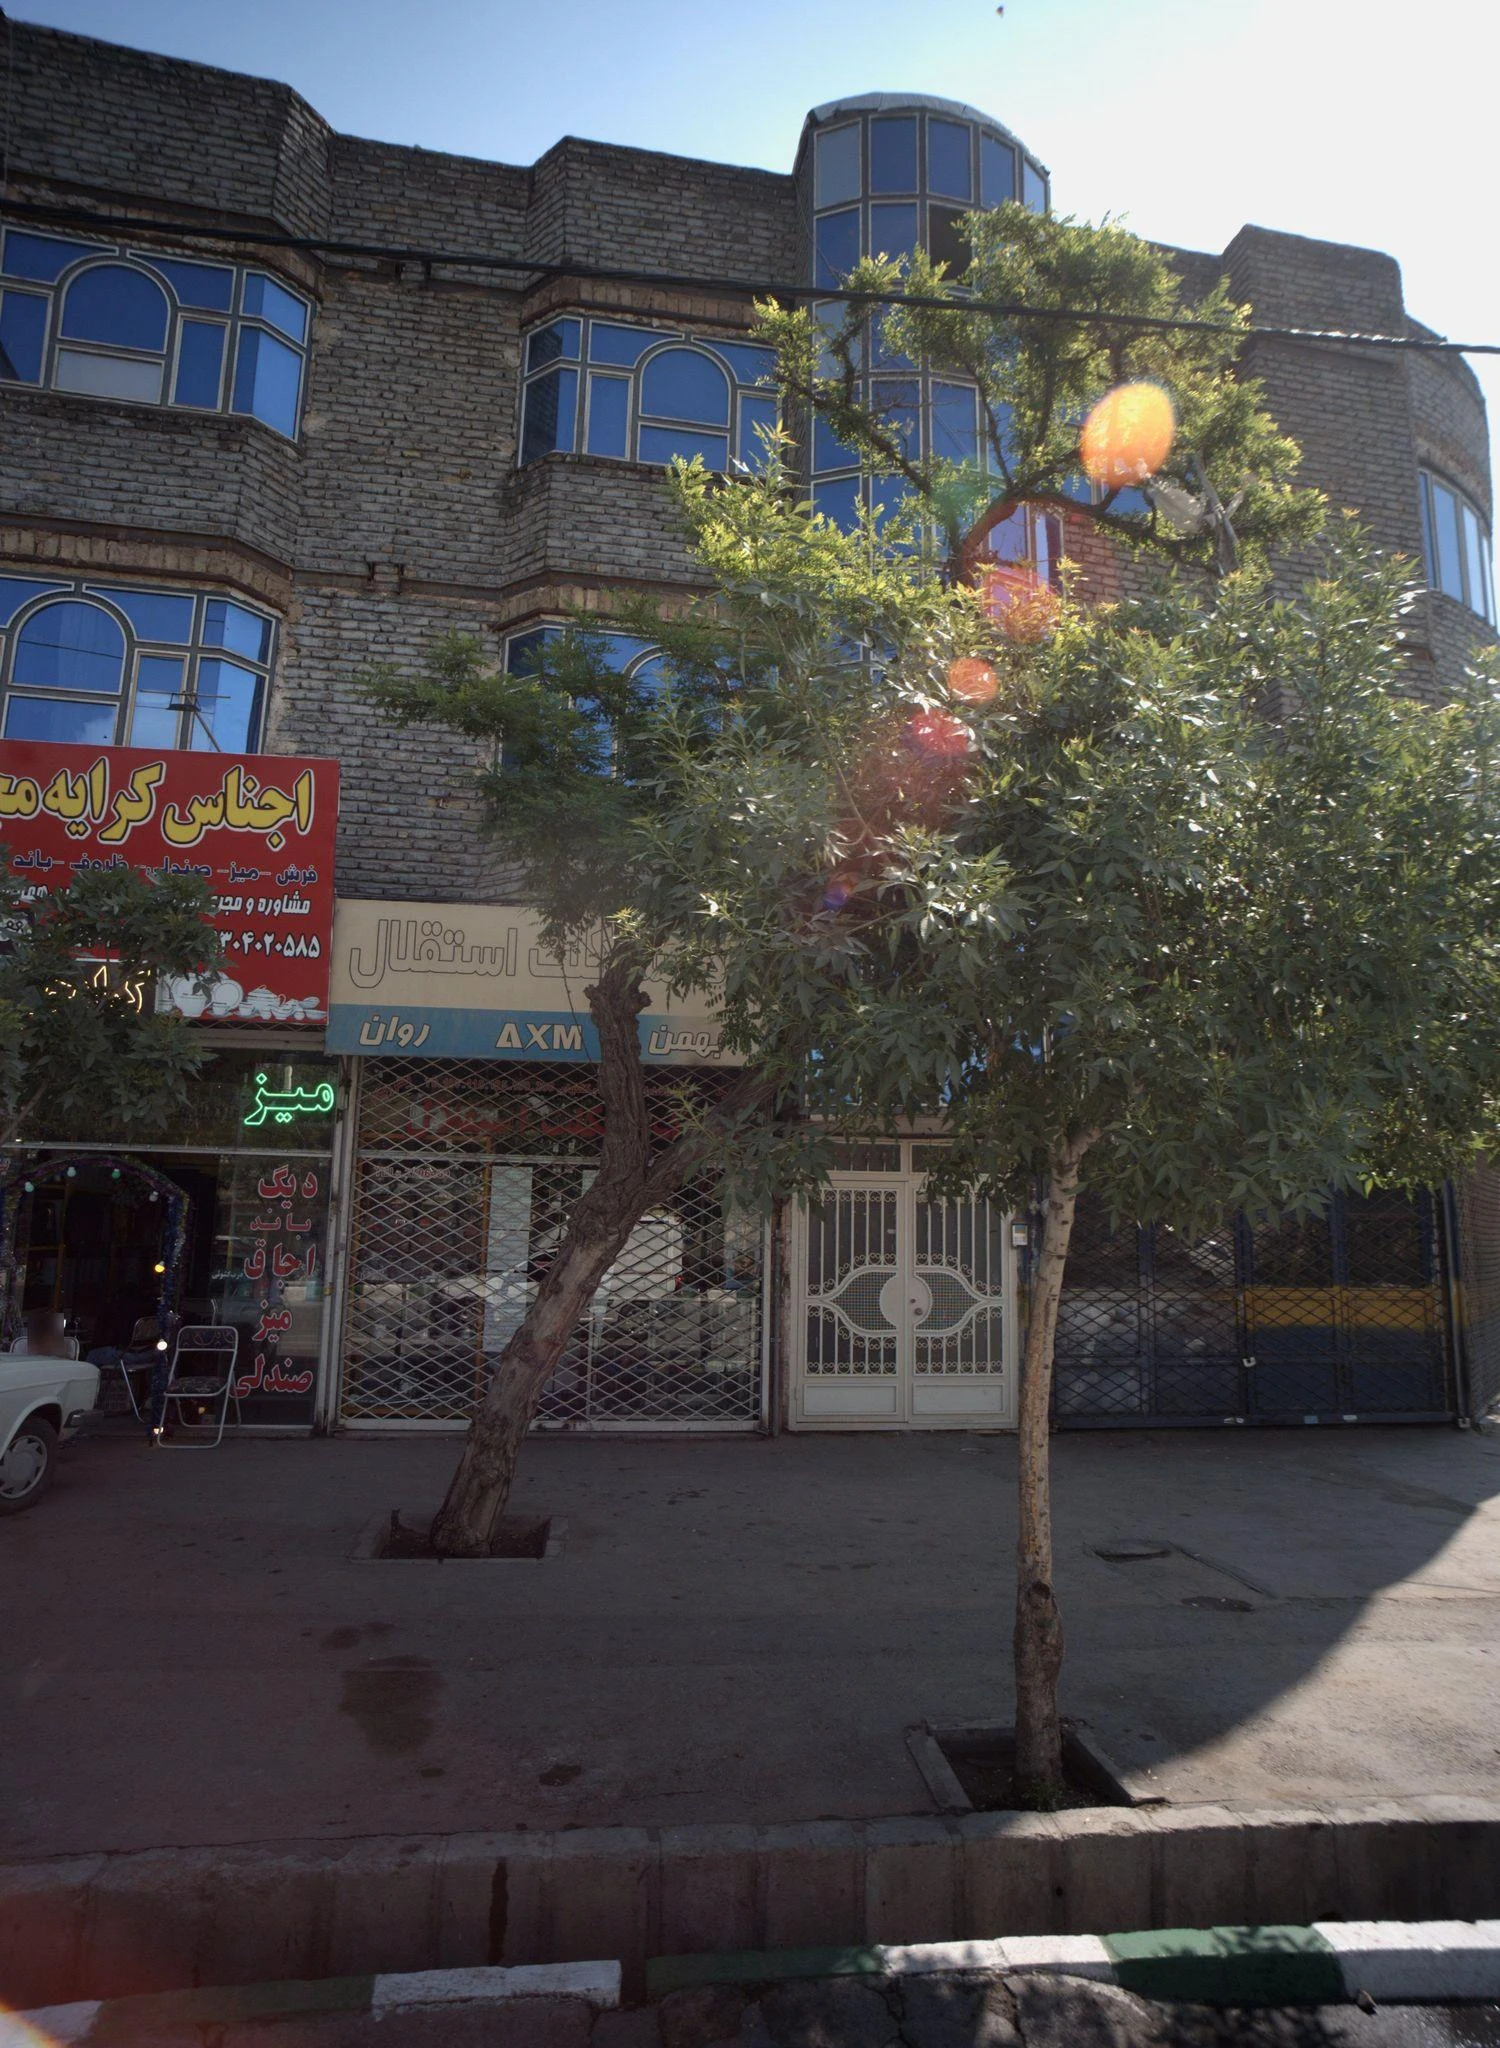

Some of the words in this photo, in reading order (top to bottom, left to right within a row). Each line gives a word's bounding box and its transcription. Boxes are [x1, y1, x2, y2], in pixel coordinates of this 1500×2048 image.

[42, 756, 167, 845] کرایه
[161, 764, 315, 851] اجناس
[13, 849, 53, 872] باند
[69, 853, 129, 873] ظروف
[228, 861, 260, 884] میز
[275, 863, 318, 886] فرش
[210, 895, 243, 917] مجر
[245, 896, 255, 917] و
[257, 890, 311, 917] مشاوره
[214, 930, 321, 960] ۳۰۴۰۲۰۵۸۵
[349, 918, 518, 989] استقلال
[359, 1014, 431, 1048] روان
[648, 1025, 722, 1059] بهمن
[244, 1072, 335, 1126] میز
[258, 1164, 318, 1208] دیگ
[250, 1207, 312, 1241] باند
[243, 1238, 316, 1289] اجاق
[252, 1299, 293, 1343] میز
[228, 1352, 313, 1399] صندلی
